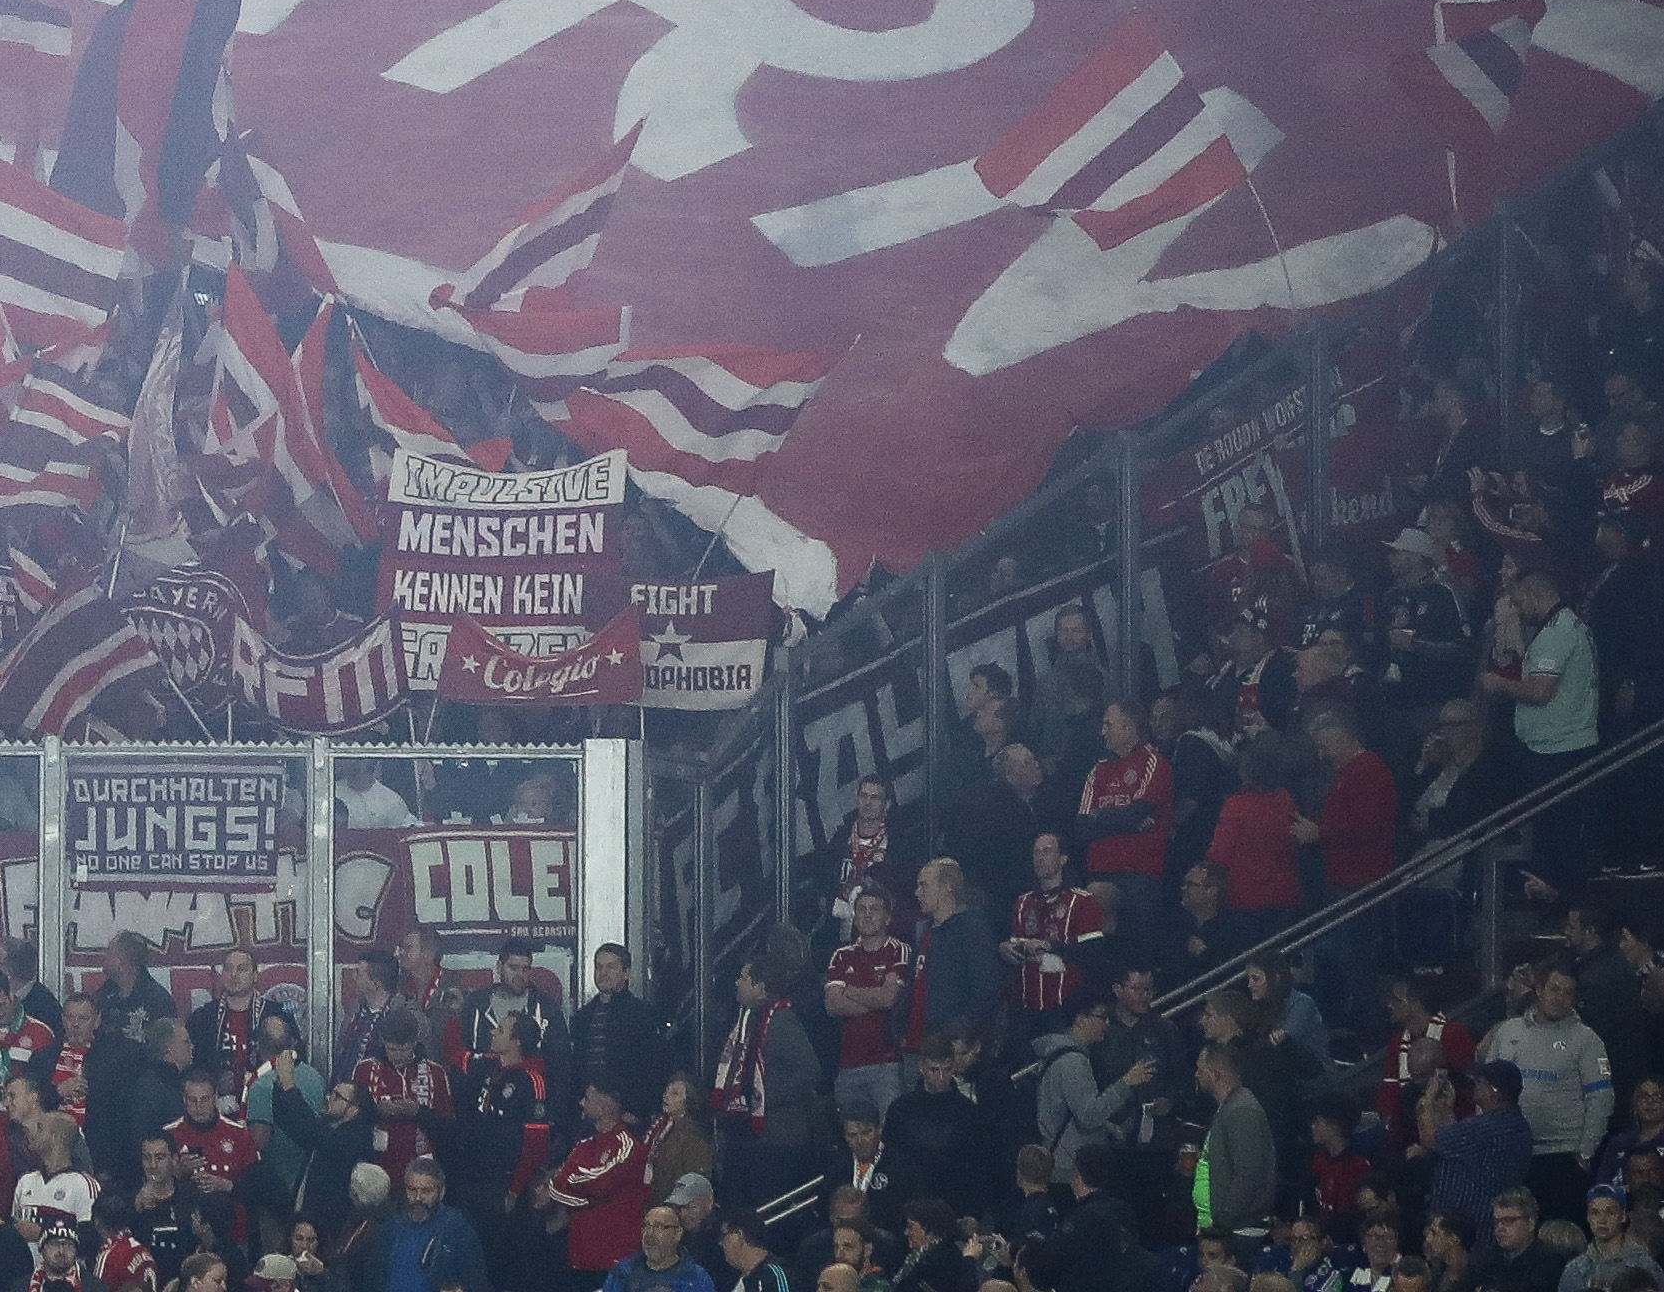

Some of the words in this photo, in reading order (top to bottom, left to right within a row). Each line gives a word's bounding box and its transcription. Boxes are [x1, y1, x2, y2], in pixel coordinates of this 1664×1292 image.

[403, 455, 611, 506] IMPULSIVE
[397, 510, 606, 559] MENSCHEN
[392, 569, 504, 615] KENNEN
[512, 572, 585, 616] KEIN
[630, 584, 719, 616] FIGHT
[73, 777, 278, 803] DURCHHALTEN
[74, 806, 276, 853] JUNGS!
[148, 853, 187, 870] CAN
[189, 853, 238, 871] STOP
[244, 854, 269, 872] US
